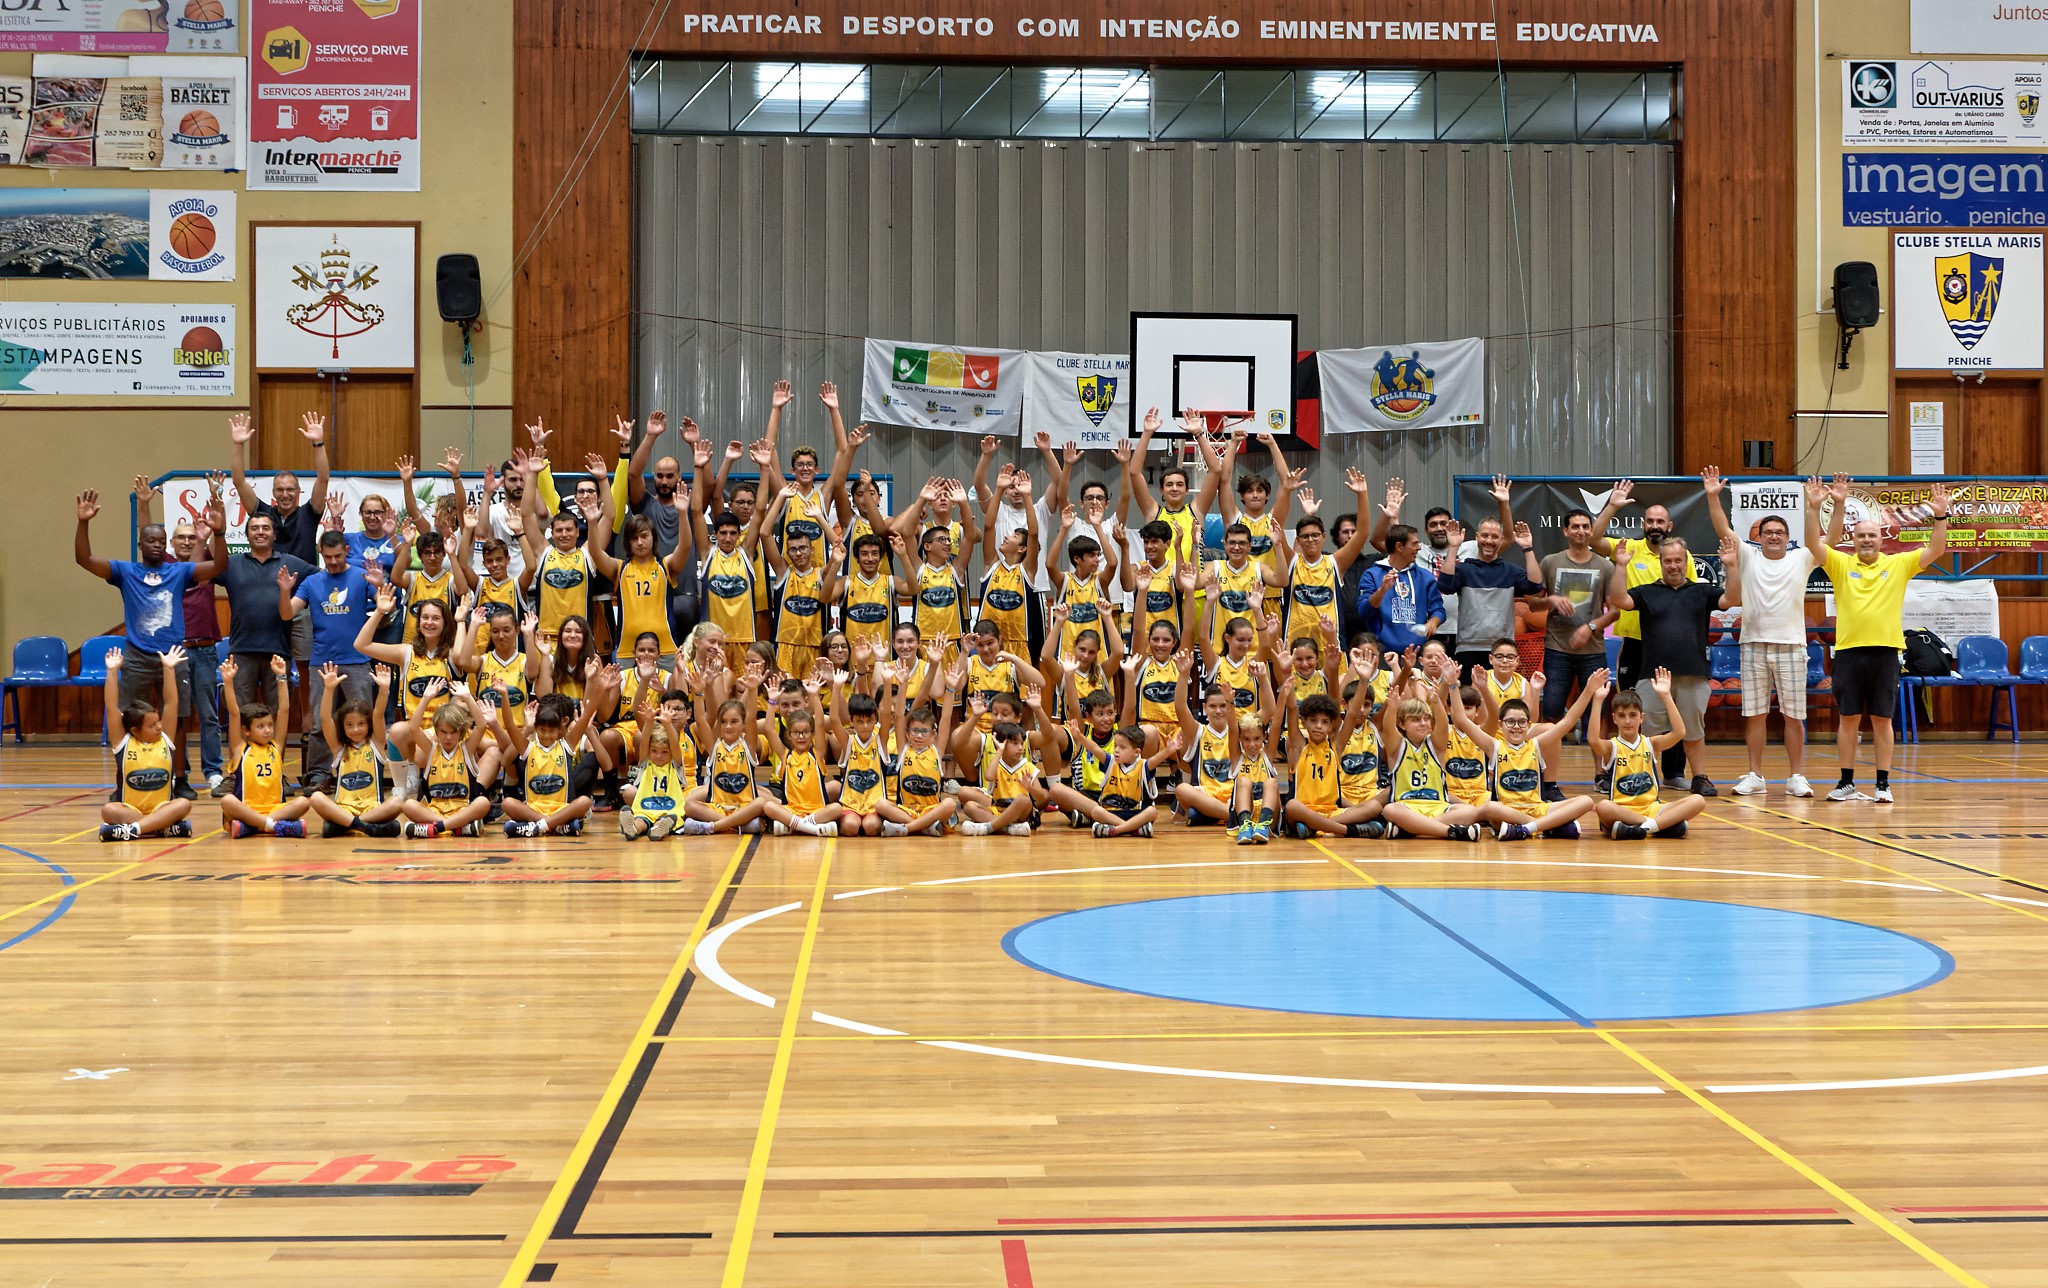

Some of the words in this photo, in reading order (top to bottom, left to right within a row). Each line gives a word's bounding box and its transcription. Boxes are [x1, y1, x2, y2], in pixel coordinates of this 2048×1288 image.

[1994, 4, 2048, 20] Juntos
[684, 14, 822, 34] PRATICAR
[843, 16, 994, 36] DESPORTO
[1016, 18, 1079, 38] COM
[1100, 16, 1240, 41] INTENÇÃO
[1260, 20, 1496, 41] EMINENTEMENTE
[1516, 22, 1658, 43] EDUCATIVA
[316, 45, 368, 56] SERVIÇO
[372, 45, 408, 55] DRIVE
[171, 89, 230, 103] BASKET
[263, 88, 311, 96] SERVIÇOS
[315, 88, 360, 96] ABERTOS
[364, 88, 406, 97] 24H/24H
[1916, 92, 2004, 106] OUT-VARIUS
[177, 136, 200, 144] STELLA
[1847, 156, 2045, 199] imagem
[169, 199, 204, 218] APOIA
[206, 205, 218, 217] O
[1969, 208, 2046, 226] peniche
[1897, 236, 1939, 248] CLUBE
[1945, 236, 1992, 248] STELLA
[1998, 236, 2041, 248] MARIS
[160, 250, 225, 274] BASQUETEBOL
[54, 317, 165, 331] PUBLICITÁRIOS
[0, 348, 142, 364] STAMPAGENS
[174, 348, 230, 365] Basket
[1948, 357, 1992, 366] PENICHE
[1057, 359, 1080, 368] CLUBE
[1084, 360, 1111, 369] STELLA
[1116, 361, 1130, 369] MAR
[1376, 392, 1404, 404] STELLA
[1406, 391, 1430, 400] MARIS
[1082, 432, 1111, 441] PENICHE
[1740, 494, 1798, 508] BASKET
[1976, 487, 1985, 501] E
[1945, 504, 1973, 514] AKE
[1978, 503, 2022, 514] AWAY
[636, 581, 651, 596] 12
[256, 764, 272, 777] 25
[796, 770, 804, 783] 9
[653, 776, 668, 792] 14
[62, 1186, 257, 1199] PENICHE
